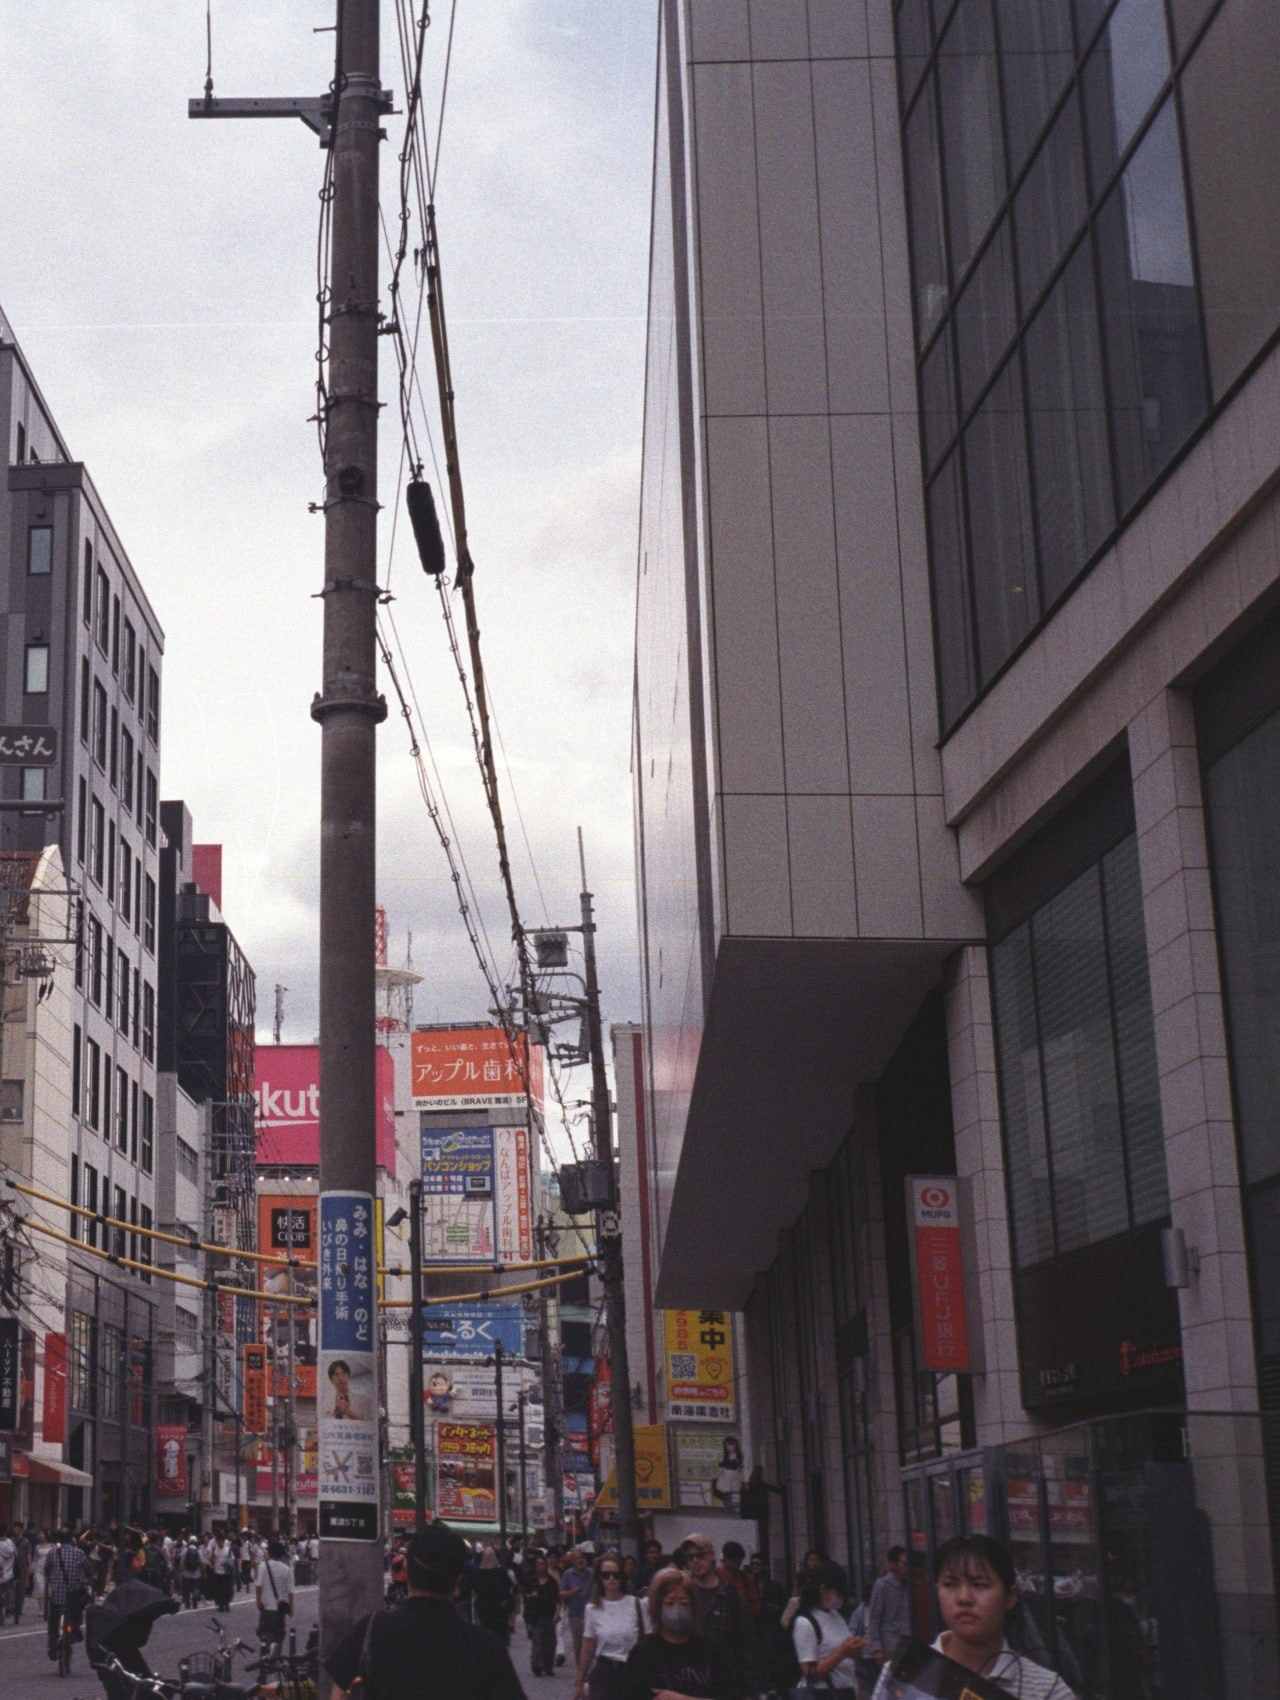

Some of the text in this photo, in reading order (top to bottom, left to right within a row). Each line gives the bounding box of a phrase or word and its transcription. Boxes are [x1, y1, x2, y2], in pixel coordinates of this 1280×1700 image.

[415, 1058, 523, 1083] アップル歯科
[423, 1160, 492, 1172] パソコンショップ
[922, 1210, 951, 1220] MUFG
[352, 1205, 368, 1341] みみ・はな・のど
[927, 1237, 955, 1358] 三菱UFJ銀行
